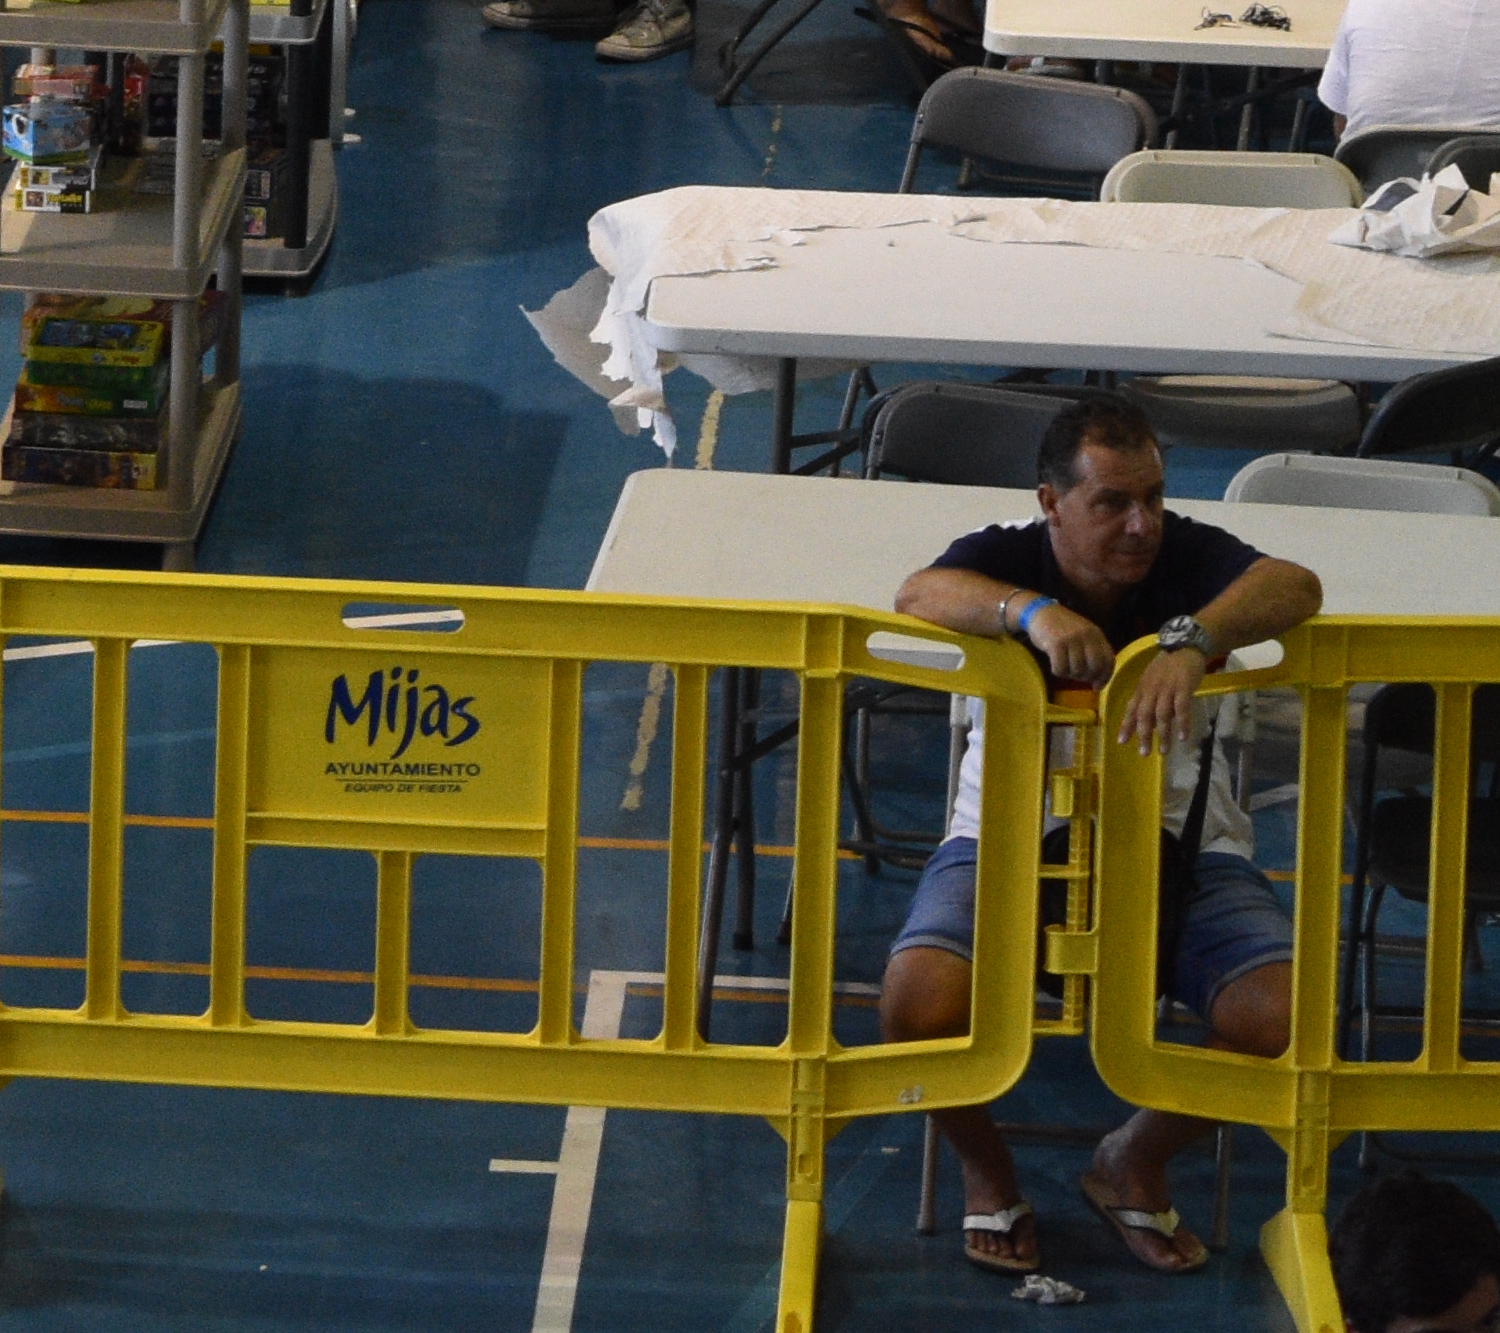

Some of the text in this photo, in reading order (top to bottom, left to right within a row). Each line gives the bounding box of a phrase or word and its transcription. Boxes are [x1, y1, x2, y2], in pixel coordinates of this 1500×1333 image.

[325, 666, 480, 761] Mijas
[324, 762, 481, 777] AYUNTAMIENTO
[344, 783, 463, 793] EQUIPO DE FIESTA
